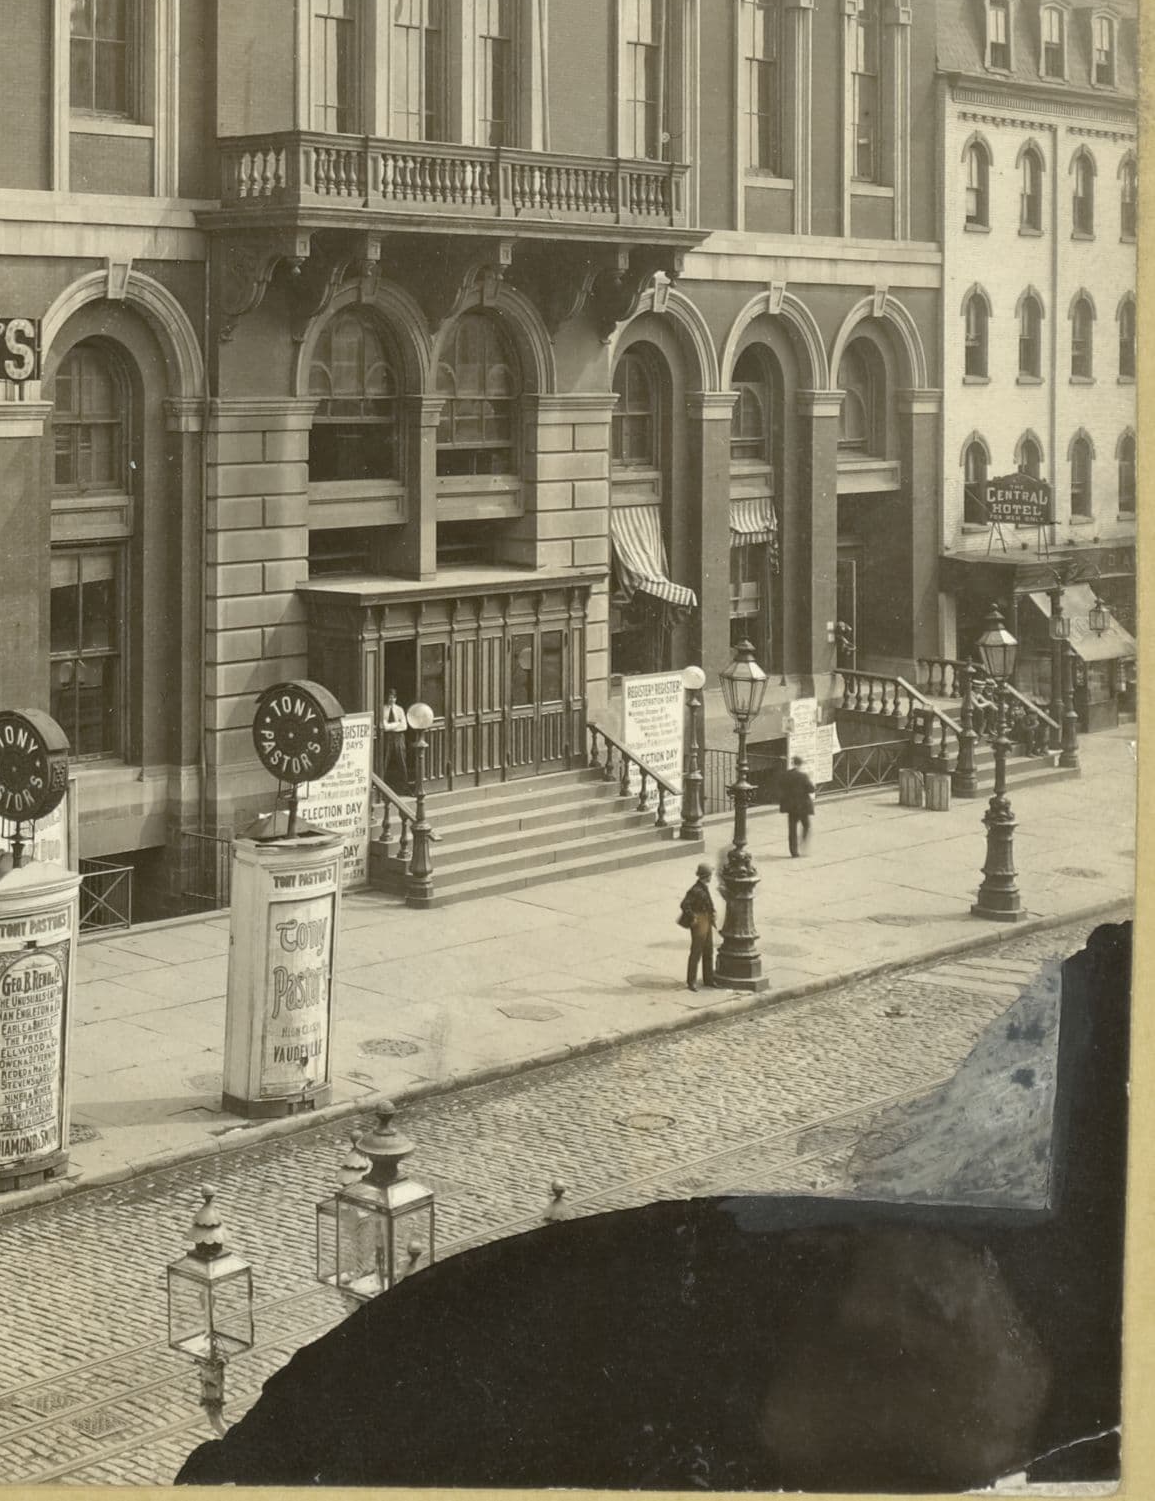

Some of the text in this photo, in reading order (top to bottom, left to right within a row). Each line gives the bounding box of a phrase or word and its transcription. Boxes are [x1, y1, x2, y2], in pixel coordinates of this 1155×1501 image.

[986, 487, 1048, 505] CENTRAL
[992, 503, 1042, 516] HOTEL
[269, 696, 316, 722] TONY
[302, 802, 363, 821] ELECTION DAY
[272, 874, 297, 889] TONY
[275, 916, 328, 957] Tony
[0, 1042, 45, 1059] ELLWOOD
